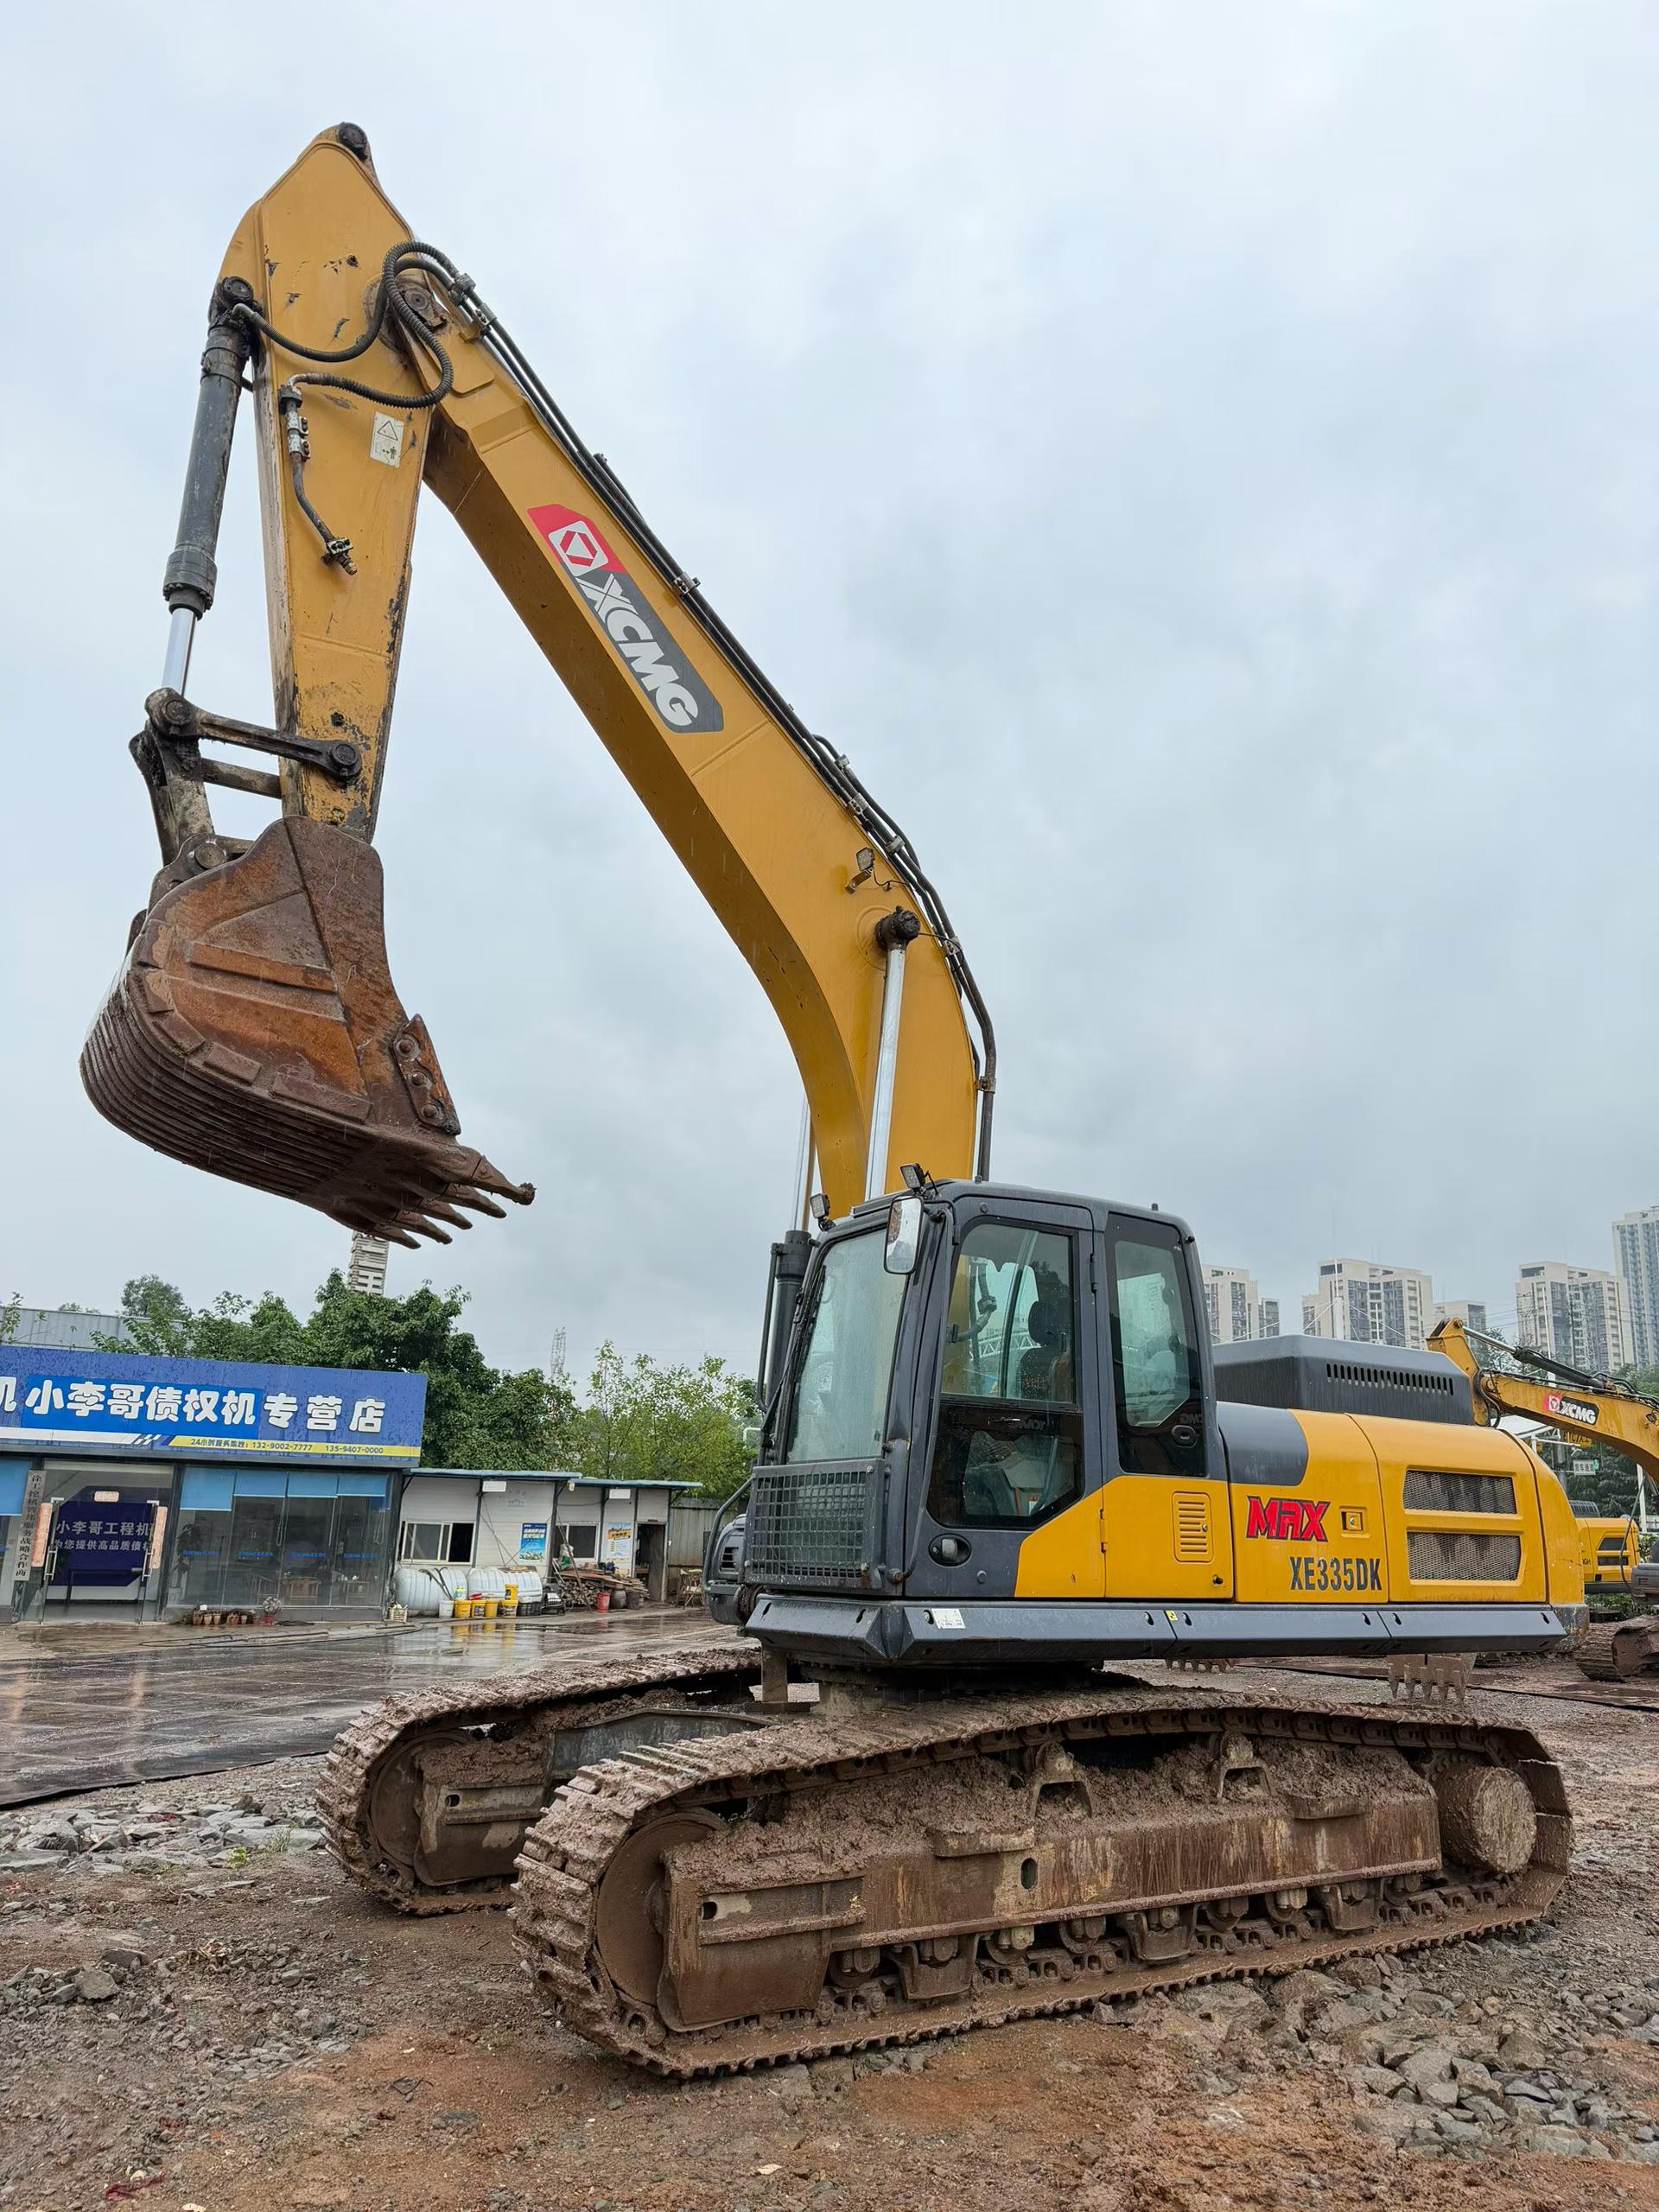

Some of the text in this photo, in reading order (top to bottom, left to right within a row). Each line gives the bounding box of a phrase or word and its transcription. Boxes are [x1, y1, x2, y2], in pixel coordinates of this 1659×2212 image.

[575, 573, 699, 727] XCMG
[1559, 1401, 1596, 1424] XCMG
[1246, 1495, 1331, 1542] MAX
[1290, 1556, 1382, 1591] XE335DK
